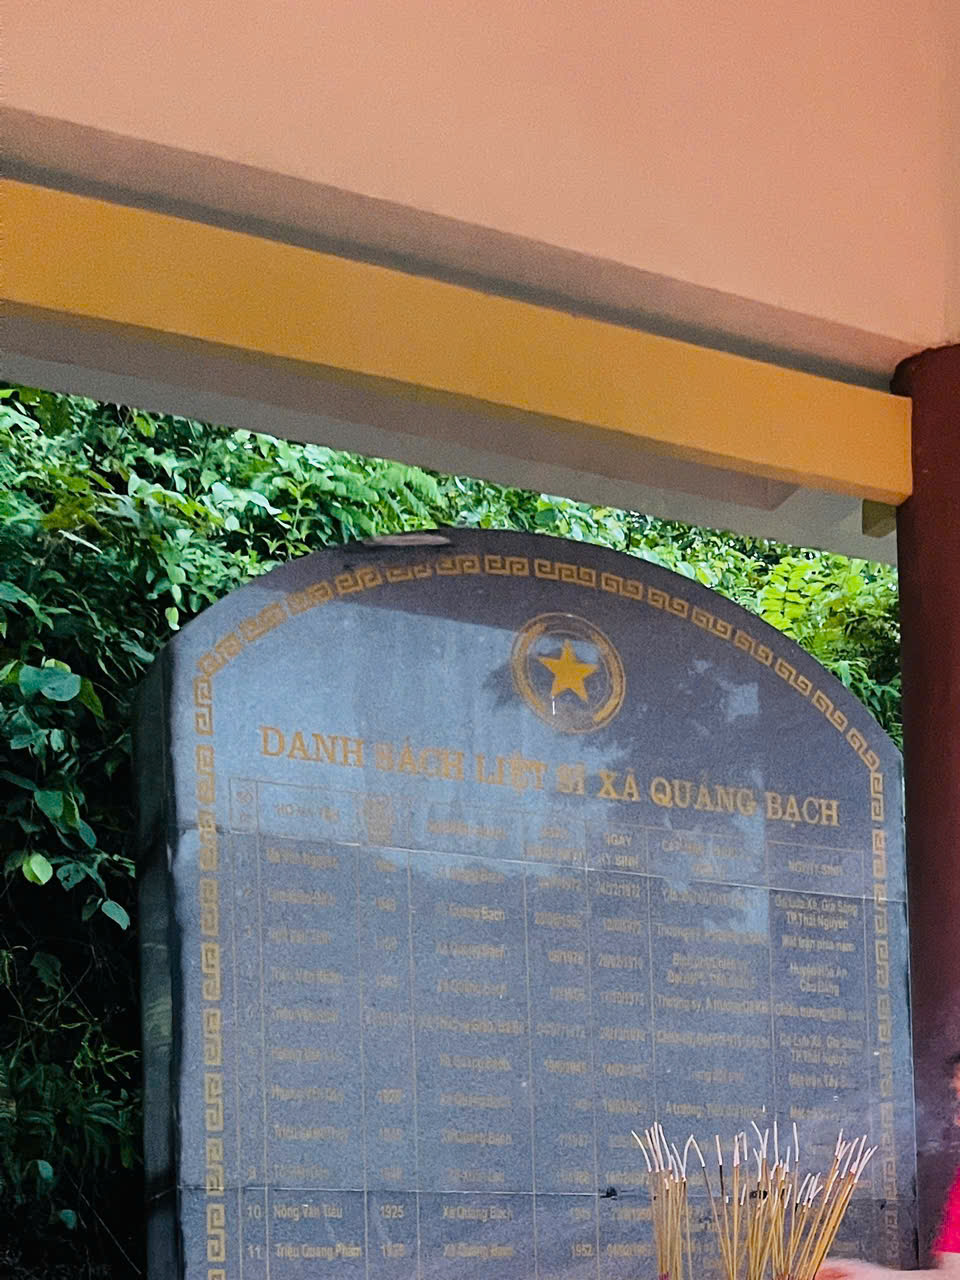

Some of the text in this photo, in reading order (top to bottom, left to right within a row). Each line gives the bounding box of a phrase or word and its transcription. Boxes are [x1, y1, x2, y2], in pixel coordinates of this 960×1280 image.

[259, 723, 366, 769] DANH
[373, 735, 465, 782] SÁCH
[764, 790, 841, 829] BẠCH
